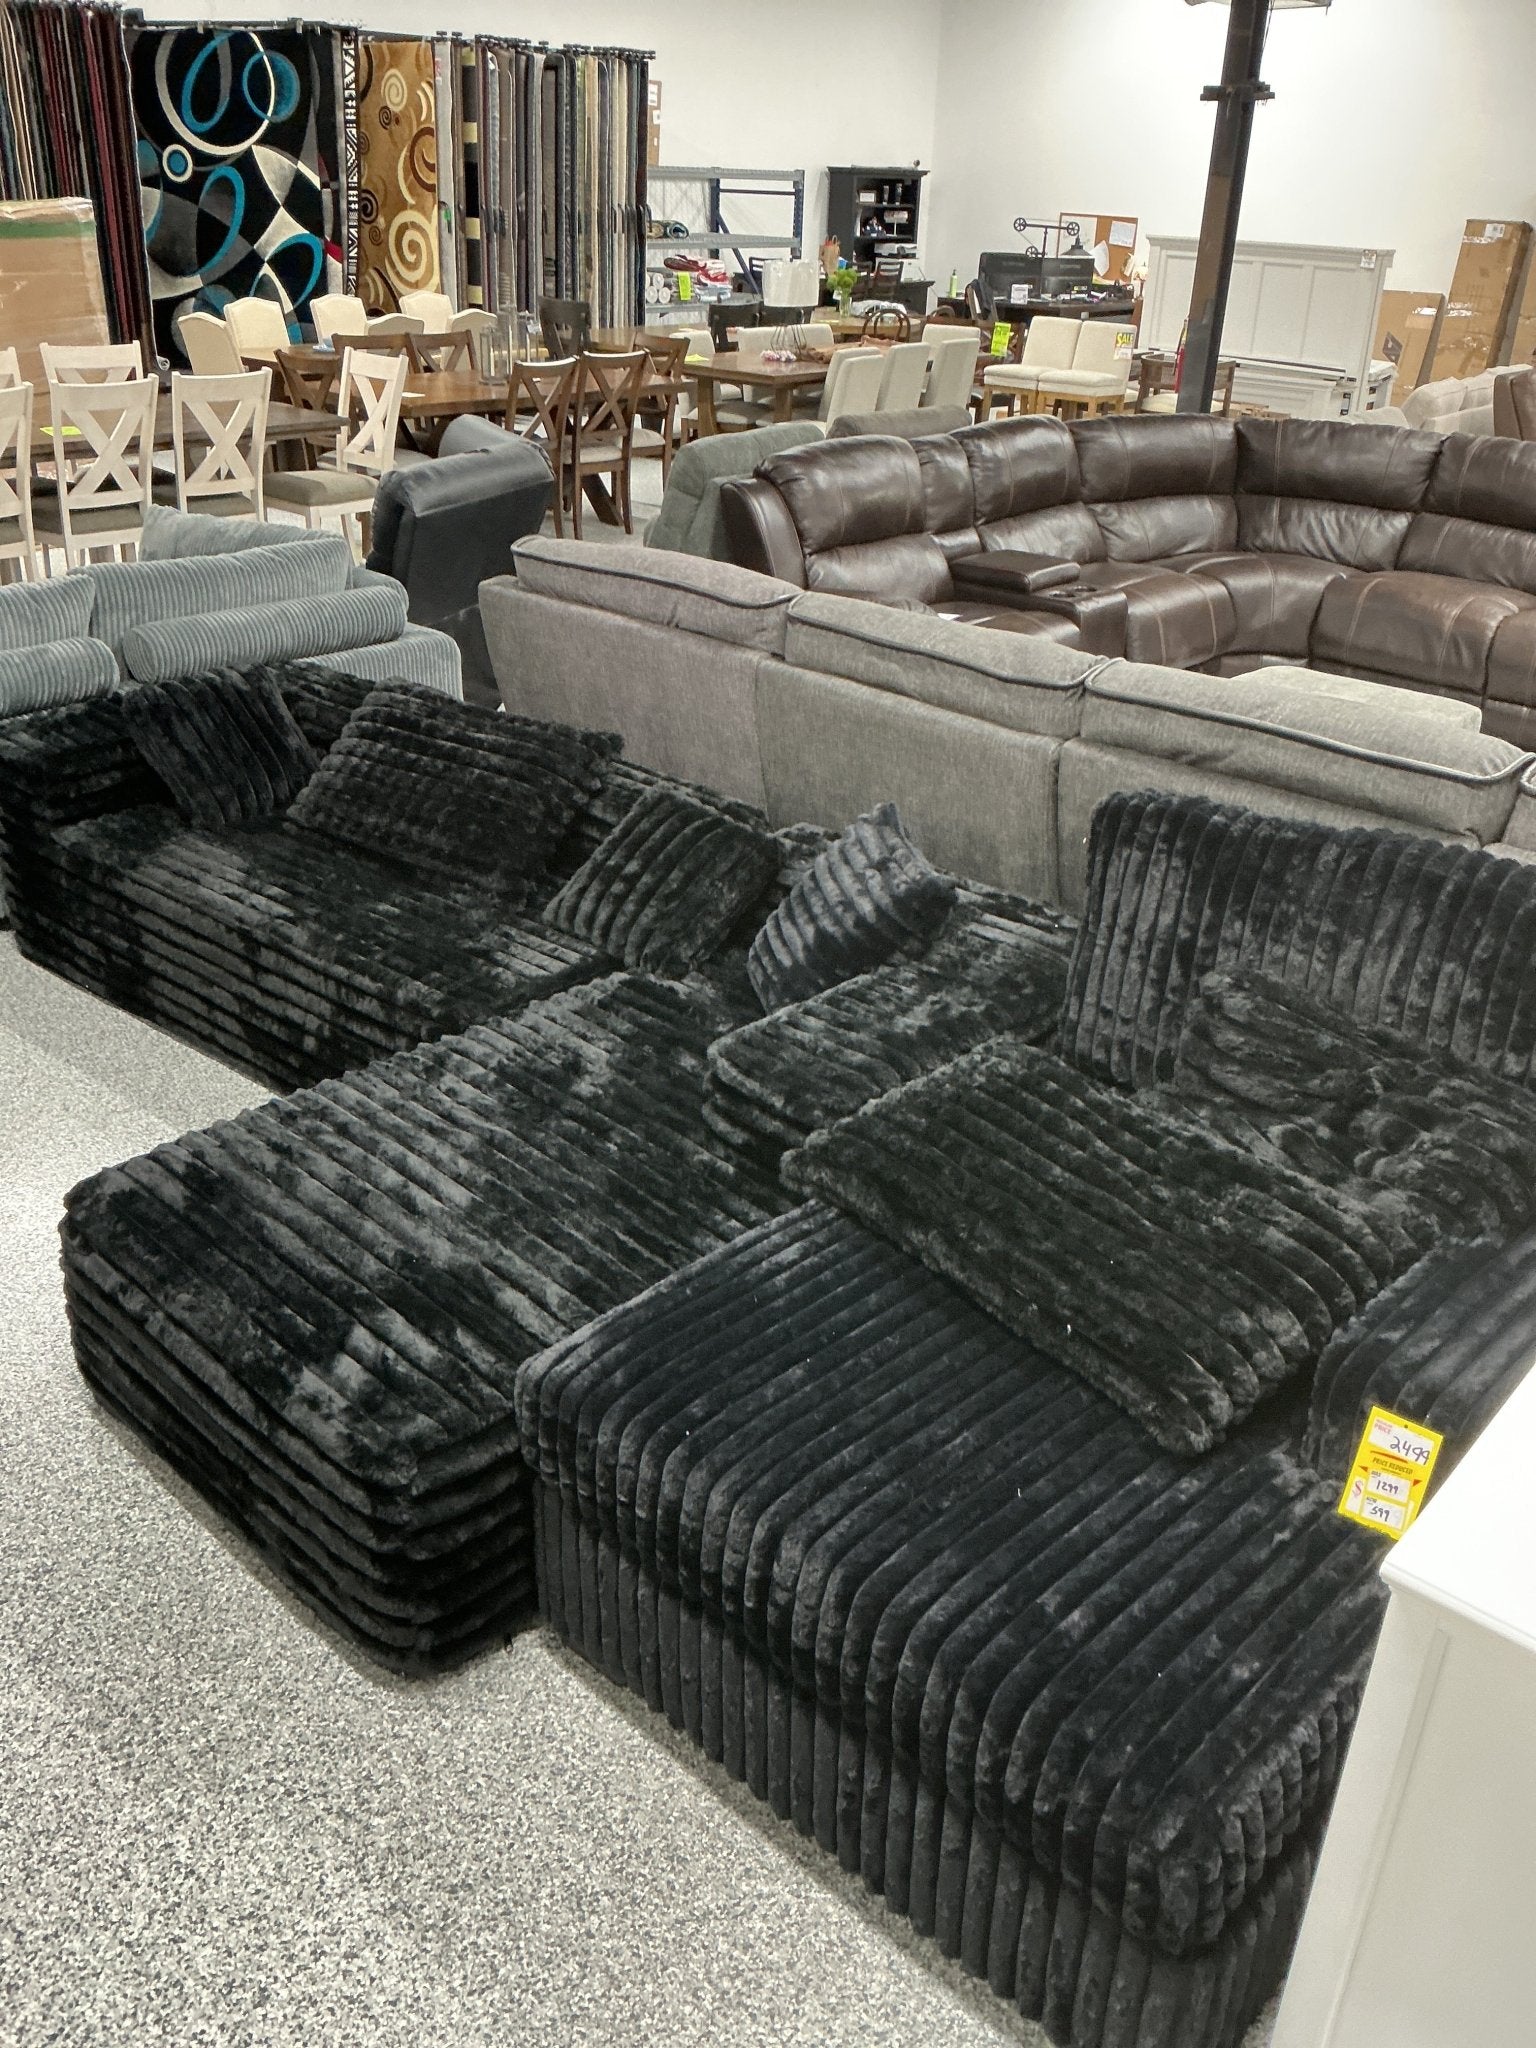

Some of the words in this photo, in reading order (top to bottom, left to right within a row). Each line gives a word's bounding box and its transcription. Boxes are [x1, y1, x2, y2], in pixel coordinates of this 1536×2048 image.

[1116, 332, 1134, 347] SALE
[1374, 1423, 1392, 1435] PRICE
[1390, 1435, 1430, 1466] 2499
[1372, 1457, 1388, 1467] PRICE
[1388, 1462, 1413, 1475] REDUCED
[1376, 1480, 1399, 1495] 1299
[1370, 1506, 1390, 1522] 599
